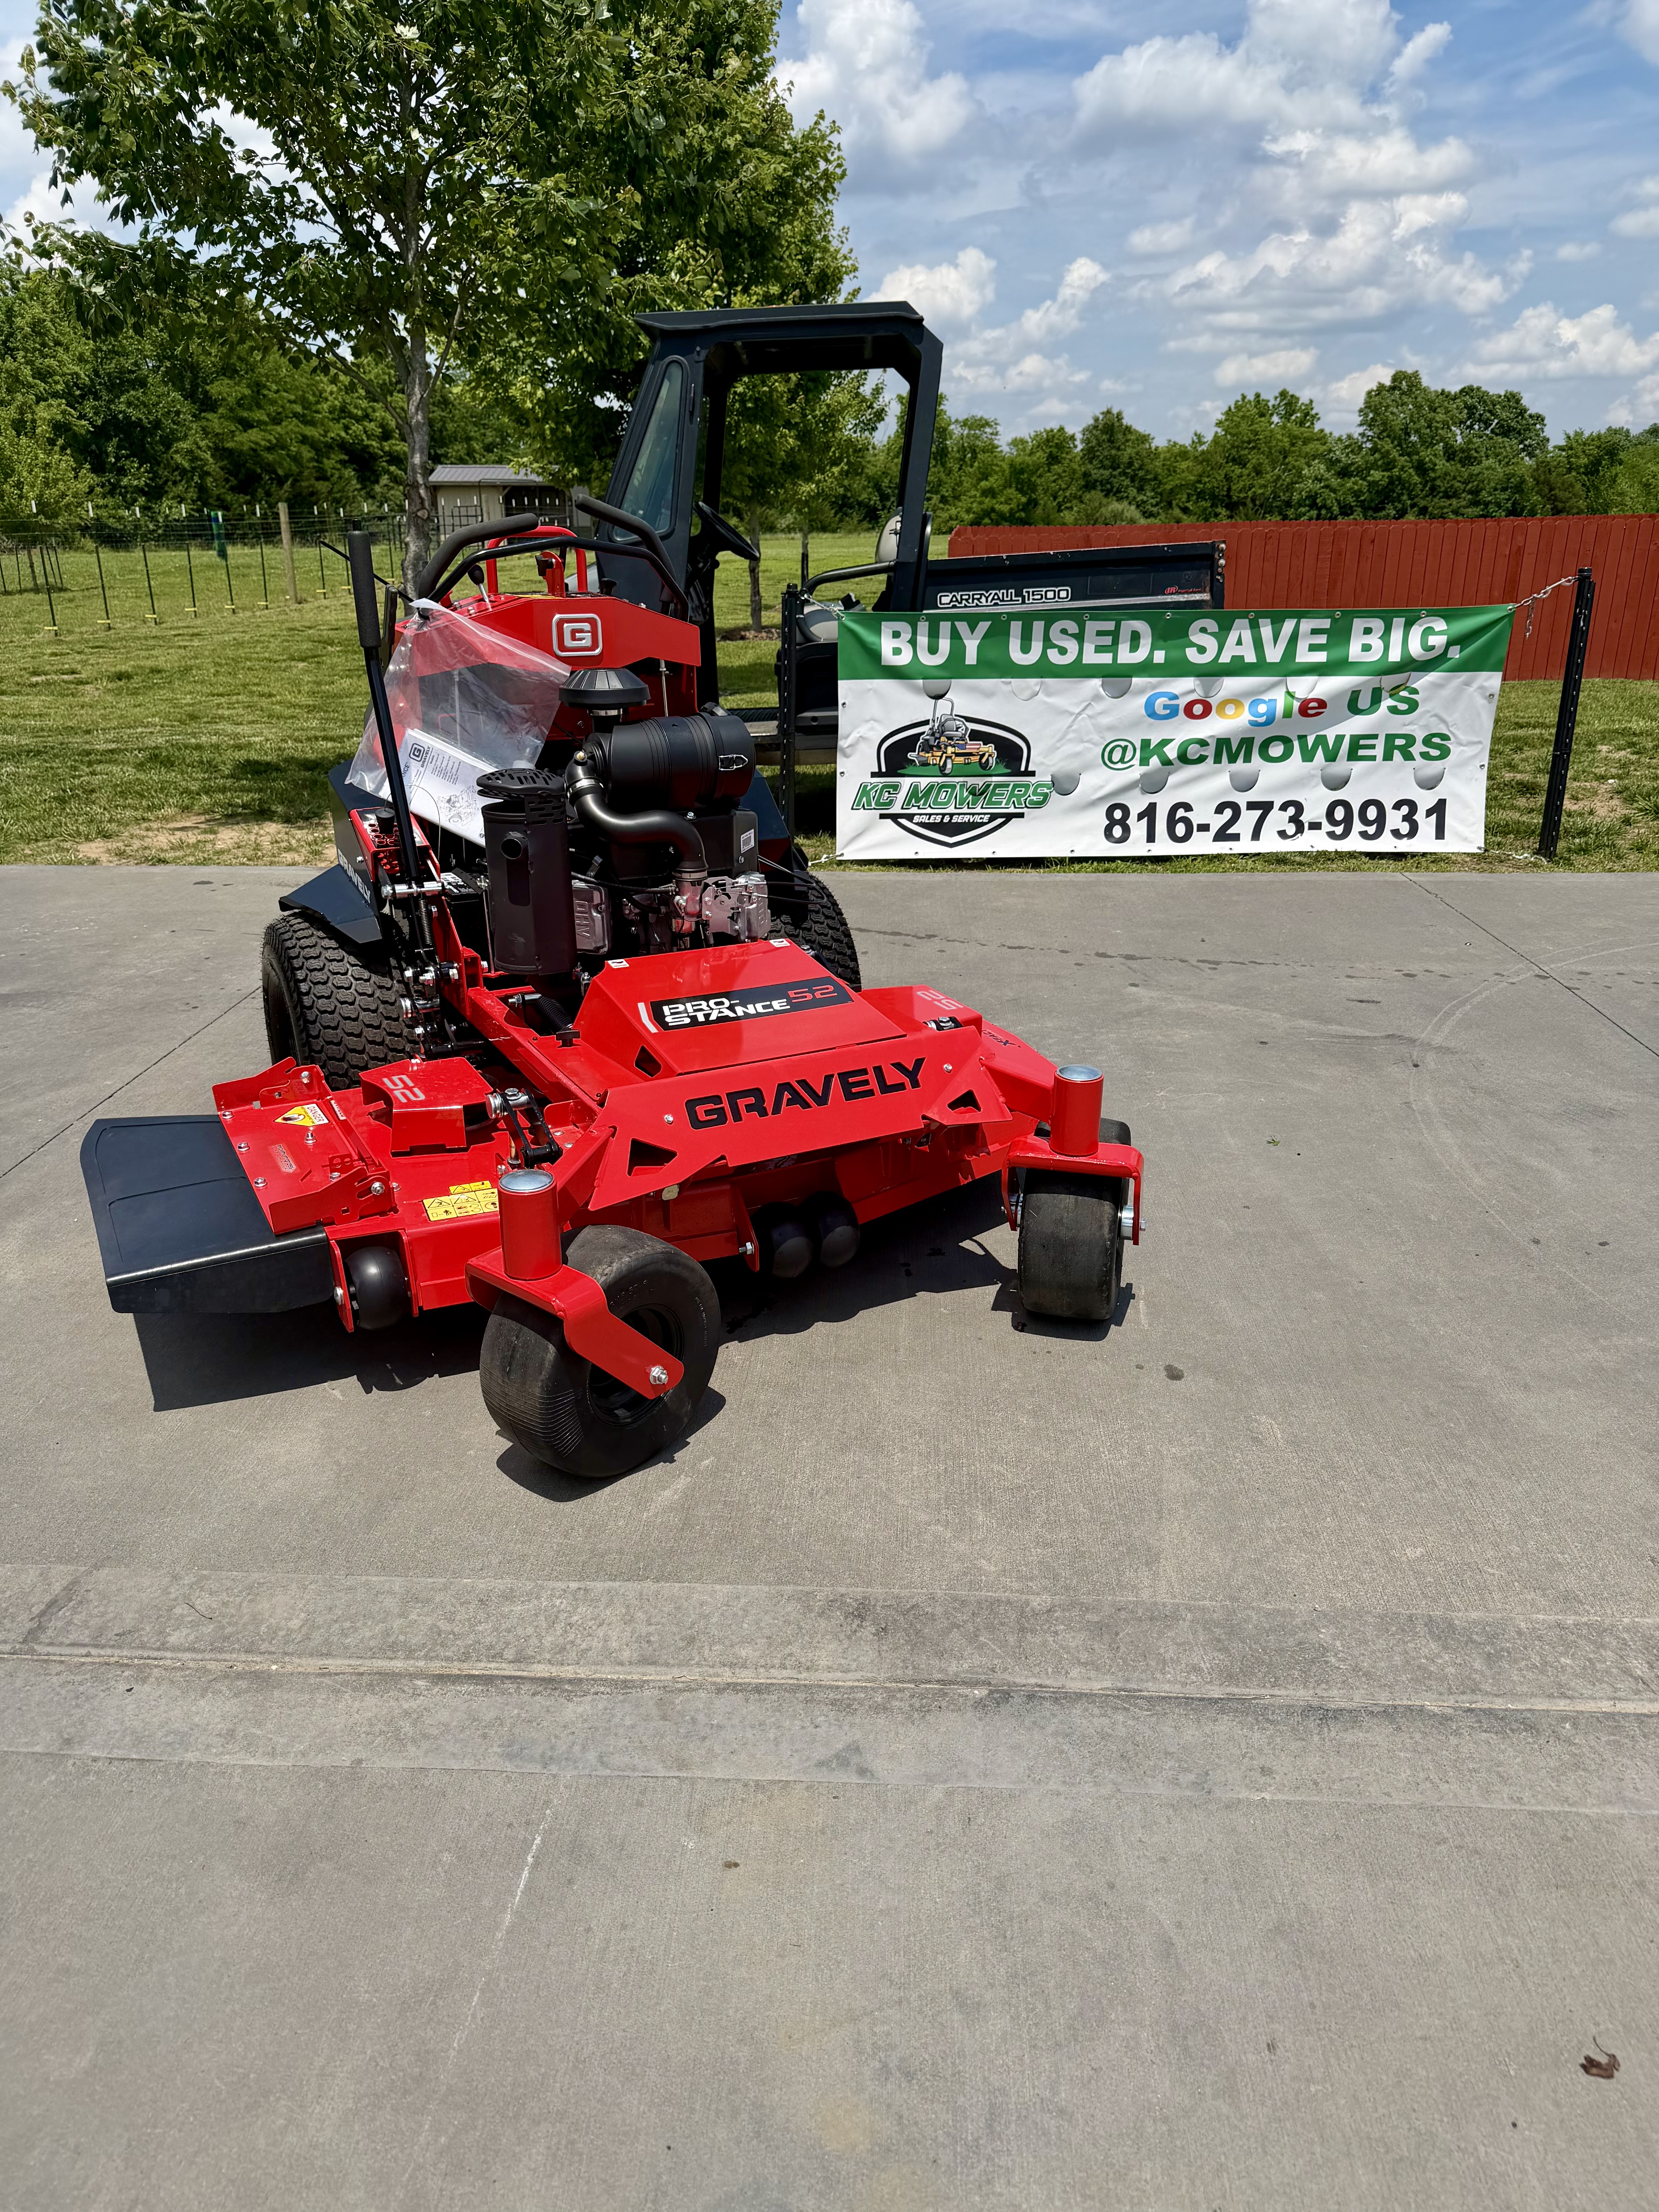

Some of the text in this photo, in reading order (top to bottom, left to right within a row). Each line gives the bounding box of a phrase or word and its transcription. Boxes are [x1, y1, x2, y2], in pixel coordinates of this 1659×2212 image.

[938, 587, 1071, 607] CARRYALL 1500
[881, 617, 1460, 665] BUY USED. SAVE BIG.
[1144, 685, 1420, 727] Google US
[421, 745, 430, 768] GRAVELY
[1101, 733, 1451, 771] @KCMOWERS
[851, 781, 1054, 810] KC MOWERS
[1103, 798, 1447, 843] 816-273-9931
[338, 849, 371, 903] GRAVELY
[575, 901, 590, 939] OHV
[662, 998, 740, 1016] PRO-
[665, 985, 837, 1026] STANCE 52
[917, 990, 963, 1010] 52
[382, 1075, 426, 1103] 52
[685, 1056, 926, 1130] GRAVELY
[307, 1106, 325, 1123] DANGER
